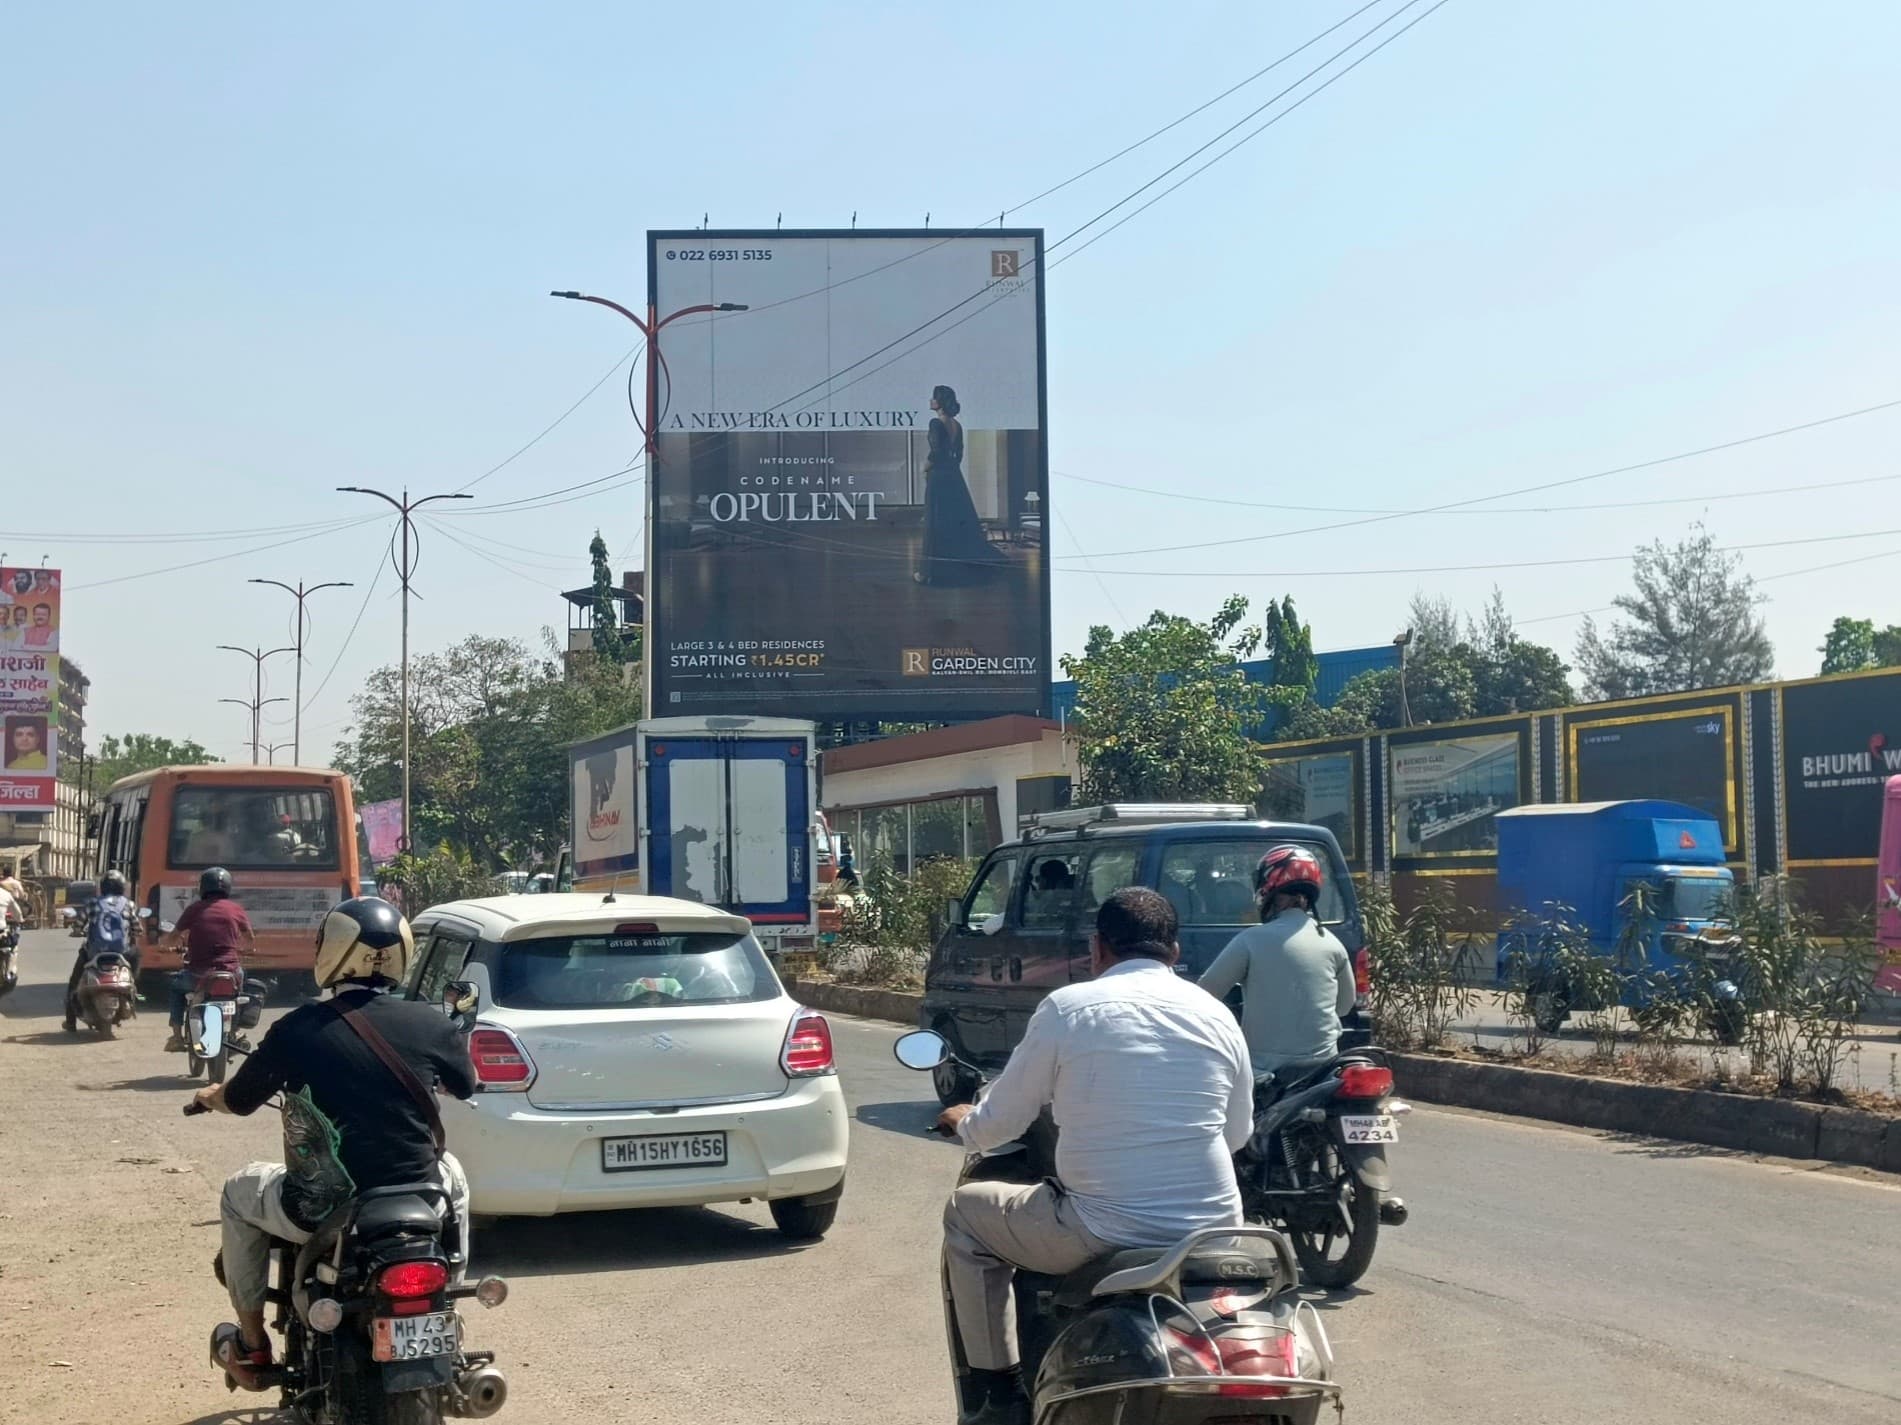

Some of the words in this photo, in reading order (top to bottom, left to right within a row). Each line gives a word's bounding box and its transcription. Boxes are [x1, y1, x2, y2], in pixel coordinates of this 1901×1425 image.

[680, 250, 705, 261] 022
[709, 250, 739, 261] 6931
[743, 250, 773, 260] 5135
[996, 253, 1014, 274] R
[670, 413, 684, 428] A
[691, 412, 743, 428] NEW
[749, 412, 789, 428] ERA
[796, 412, 825, 428] OF
[831, 411, 918, 427] LUXURY
[740, 476, 855, 485] CODENAME
[710, 492, 885, 522] OPULENT
[671, 641, 705, 650] LARGE
[708, 641, 714, 650] 3
[717, 641, 725, 649] &
[728, 641, 735, 649] 4
[738, 641, 758, 649] BED
[762, 640, 825, 649] RESIDENCES
[671, 654, 746, 667] STARTING
[906, 651, 925, 672] R
[932, 648, 976, 656] RUNWAL
[932, 657, 998, 670] GARDEN
[1002, 657, 1037, 669] CITY
[1802, 752, 1872, 776] BHUMI
[1348, 1130, 1393, 1141] 4234
[616, 1138, 722, 1163] MH15HY1656
[395, 1319, 416, 1337] MH
